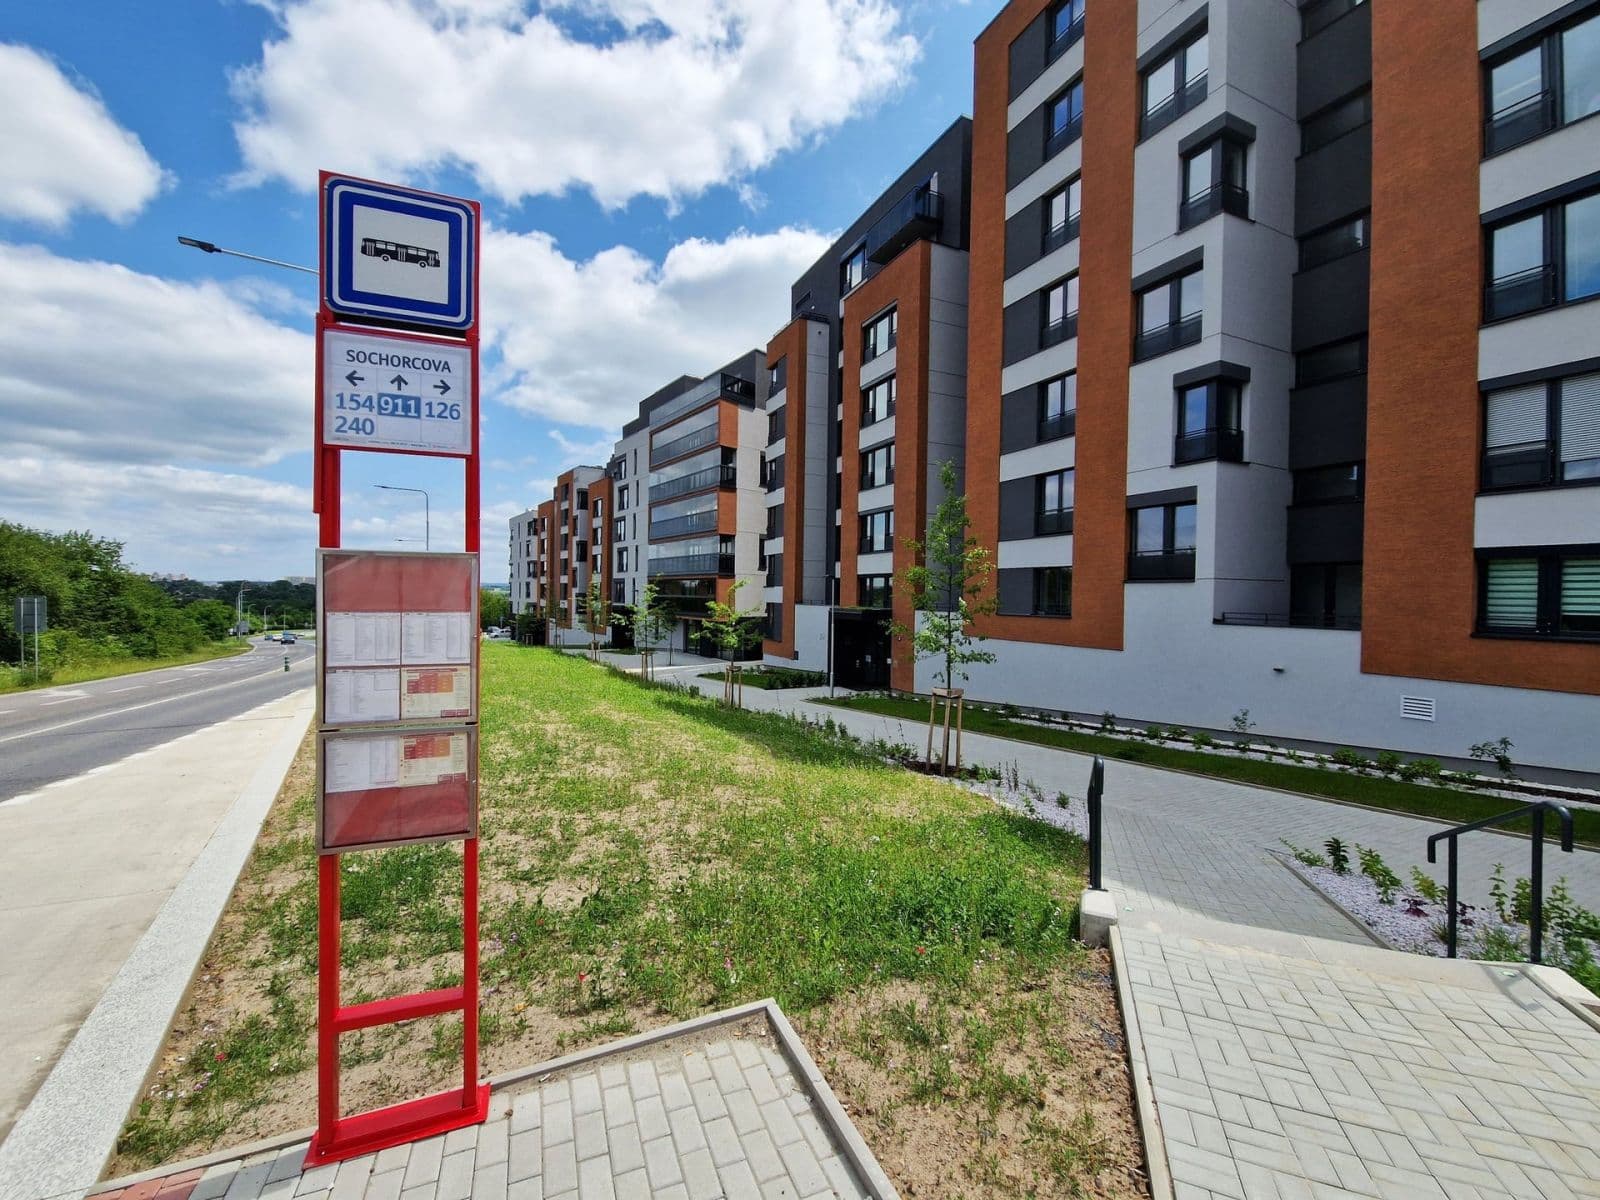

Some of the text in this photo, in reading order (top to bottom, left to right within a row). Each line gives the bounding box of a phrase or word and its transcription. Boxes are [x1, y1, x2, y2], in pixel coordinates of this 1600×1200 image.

[346, 349, 451, 373] SOCHORCOVA
[335, 392, 461, 421] 154 911 126
[334, 415, 375, 436] 240
